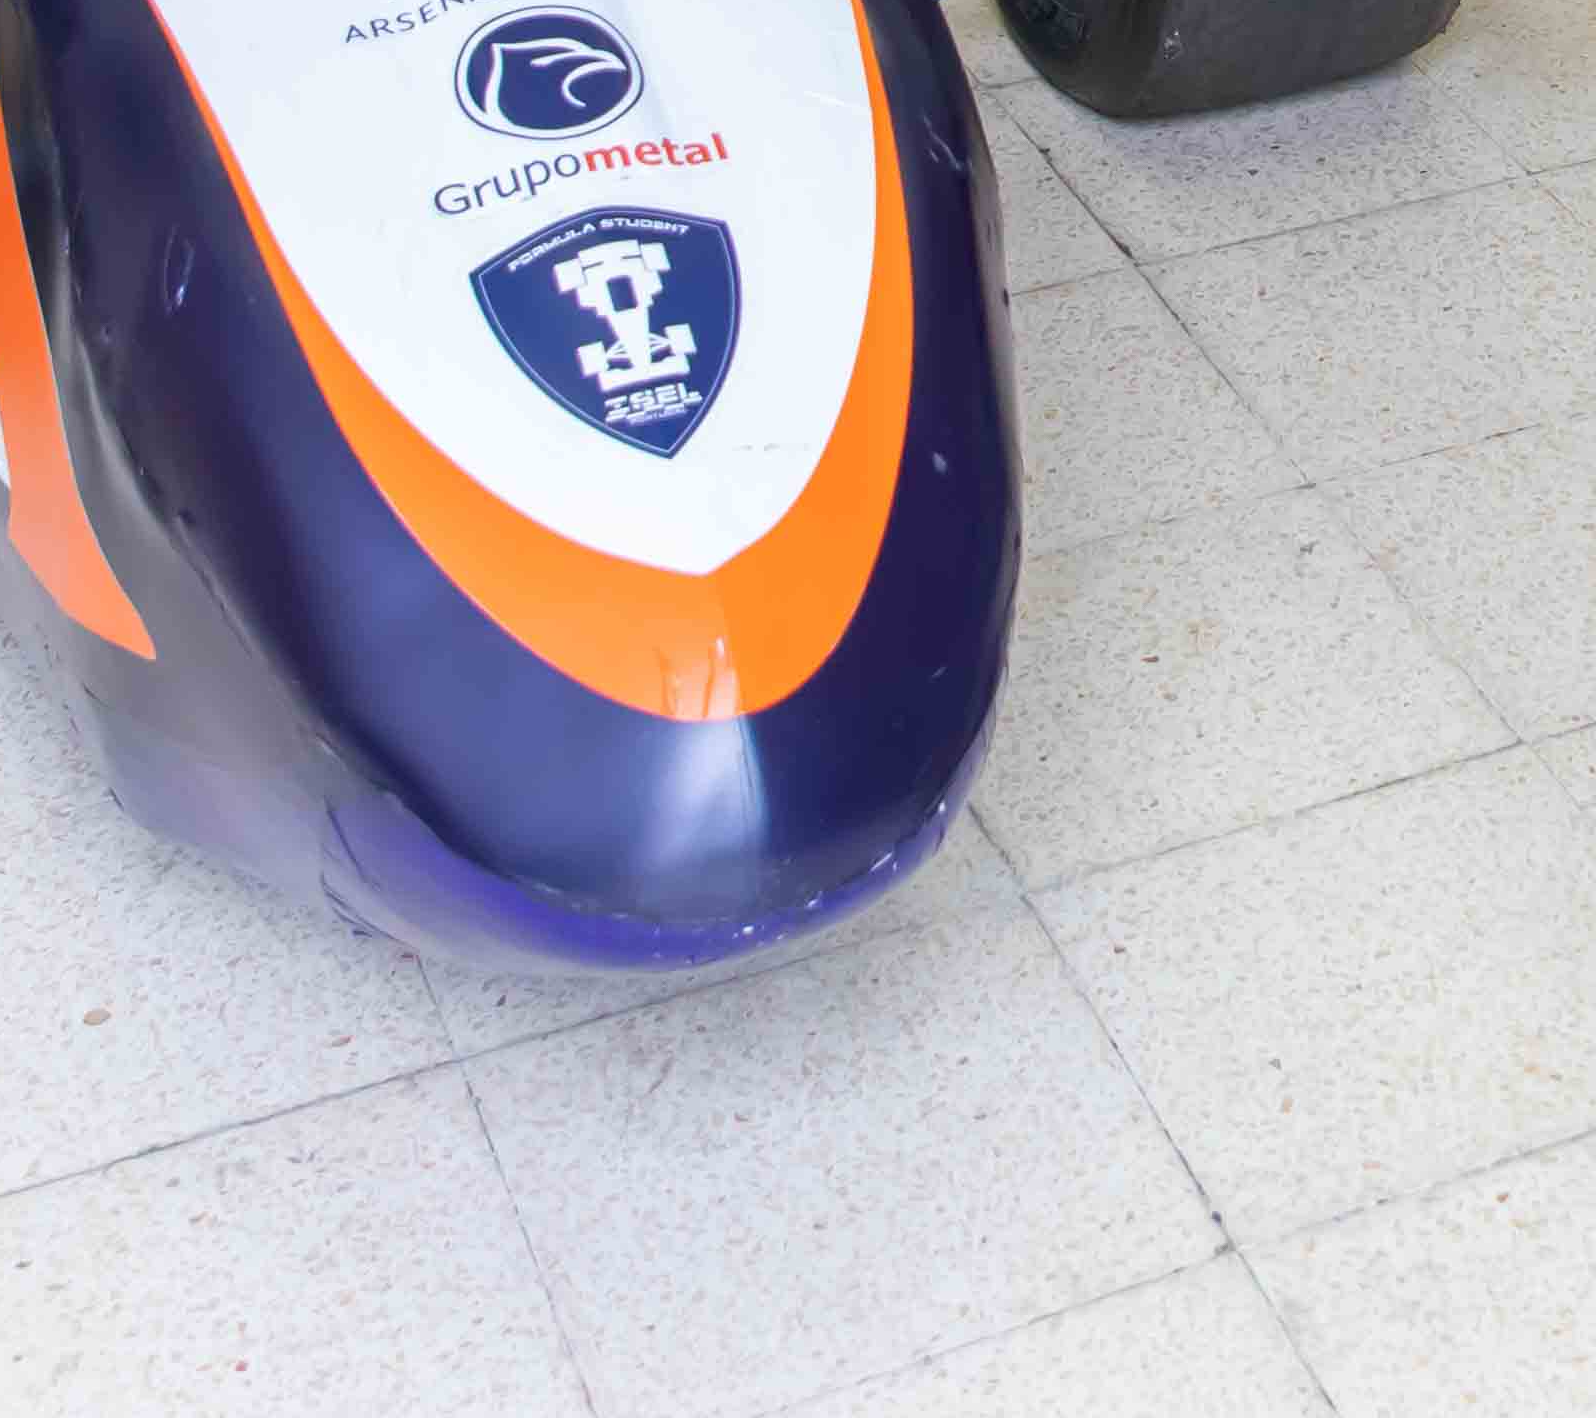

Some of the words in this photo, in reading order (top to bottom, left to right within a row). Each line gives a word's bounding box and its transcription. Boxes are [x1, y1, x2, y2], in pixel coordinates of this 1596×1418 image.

[432, 131, 731, 219] Grupometal
[507, 222, 597, 273] FORMULA
[599, 216, 690, 236] STUDENT
